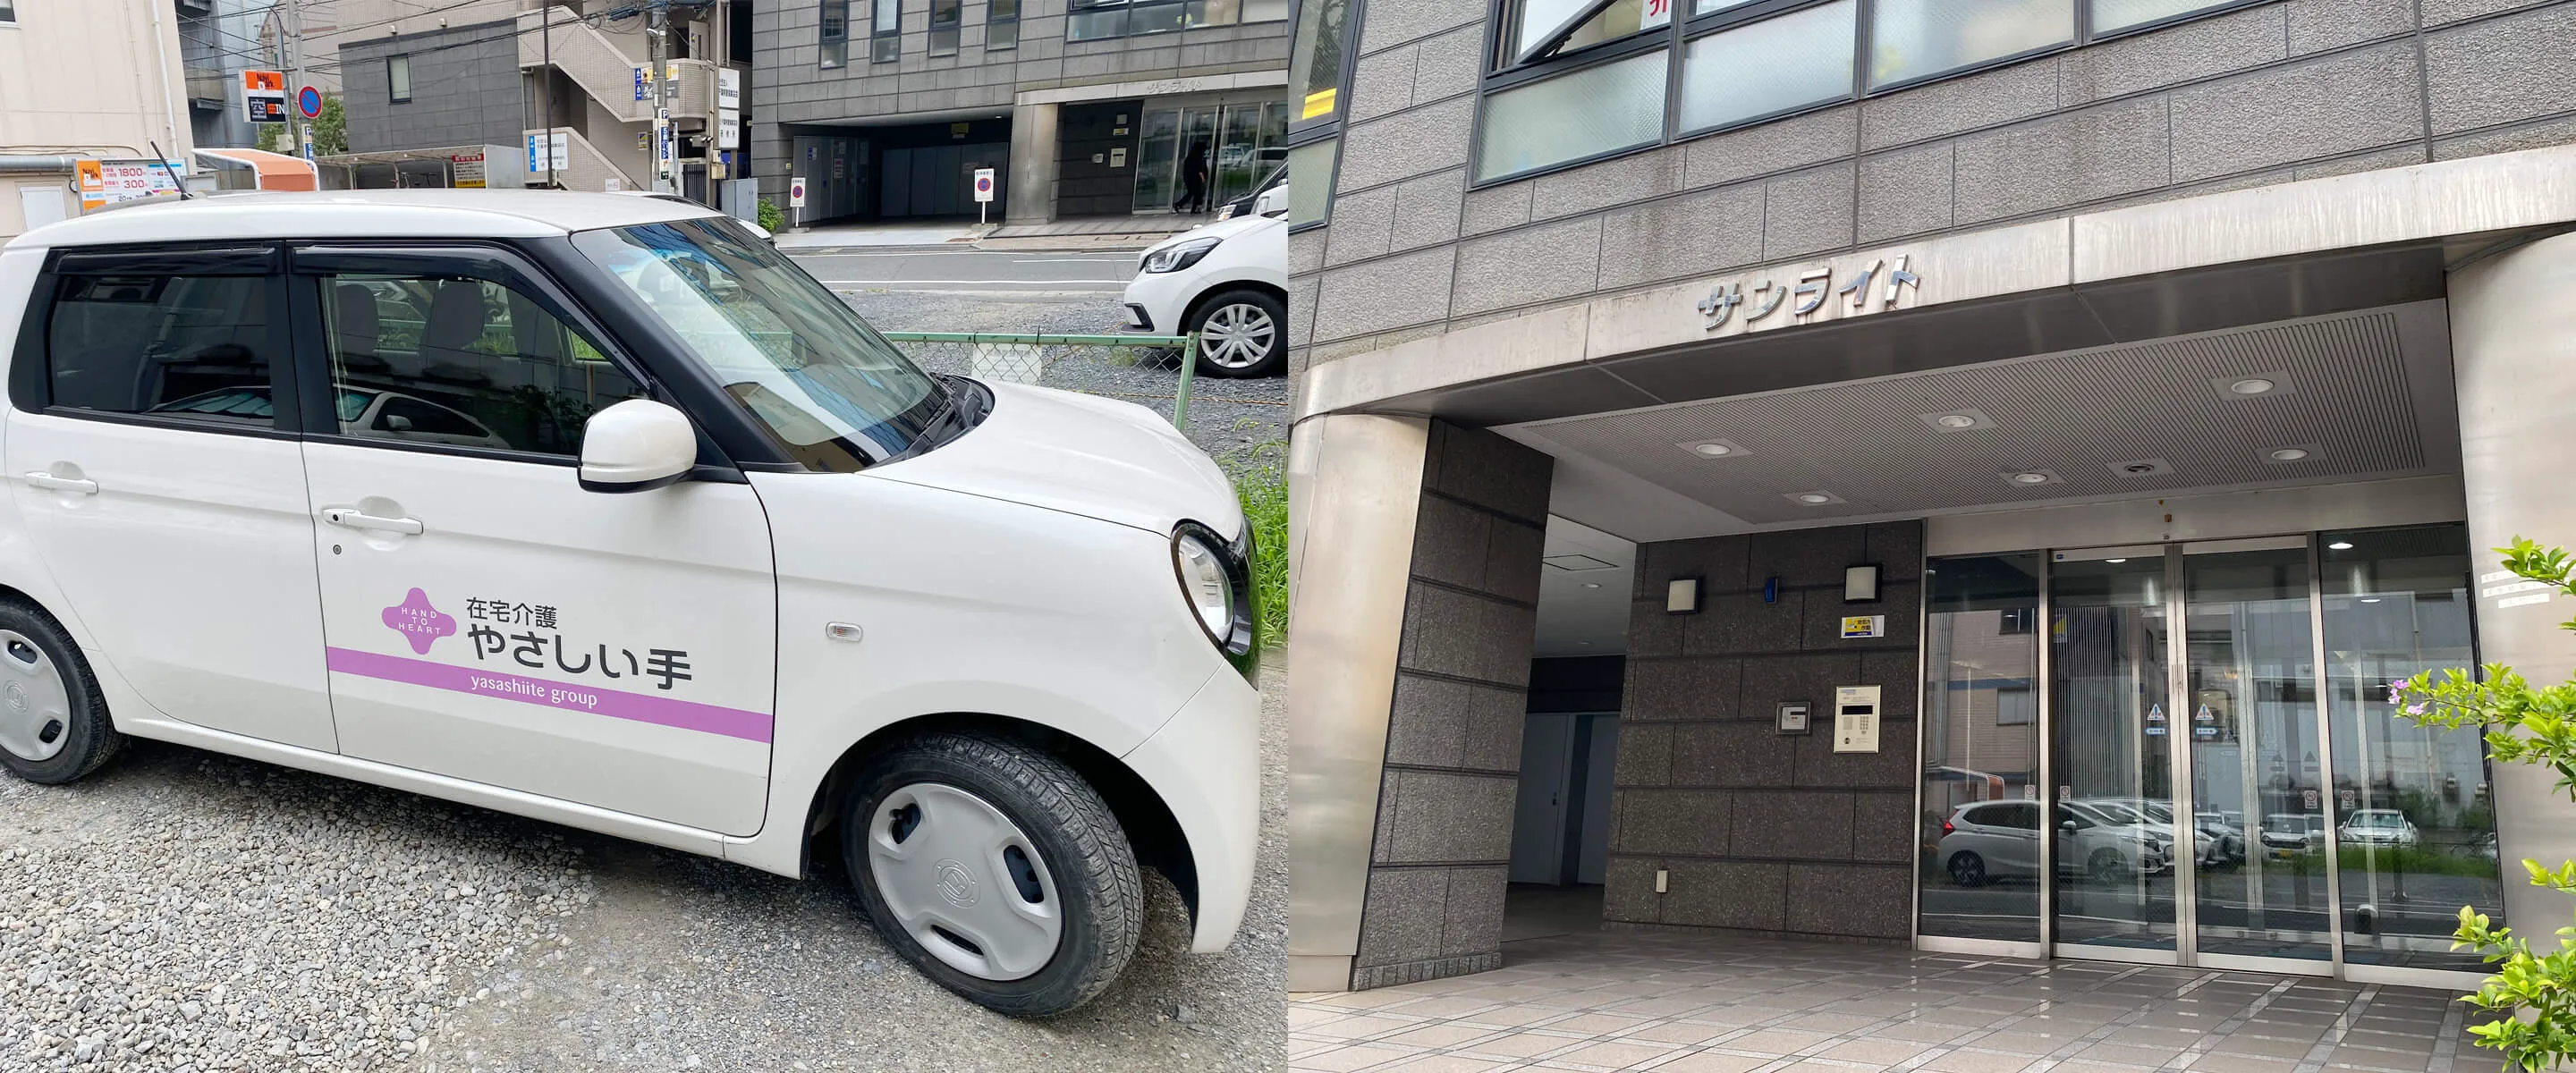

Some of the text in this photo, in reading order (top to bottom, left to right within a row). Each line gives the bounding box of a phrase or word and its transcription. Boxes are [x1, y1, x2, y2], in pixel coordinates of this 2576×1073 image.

[275, 104, 286, 115] IN
[1698, 254, 1920, 331] サンライト
[401, 607, 437, 619] HAND
[411, 616, 428, 626] TO
[466, 596, 557, 629] 在宅介護
[398, 622, 441, 636] HEART
[468, 623, 692, 690] やさしい手
[470, 676, 597, 709] yasashiite group
